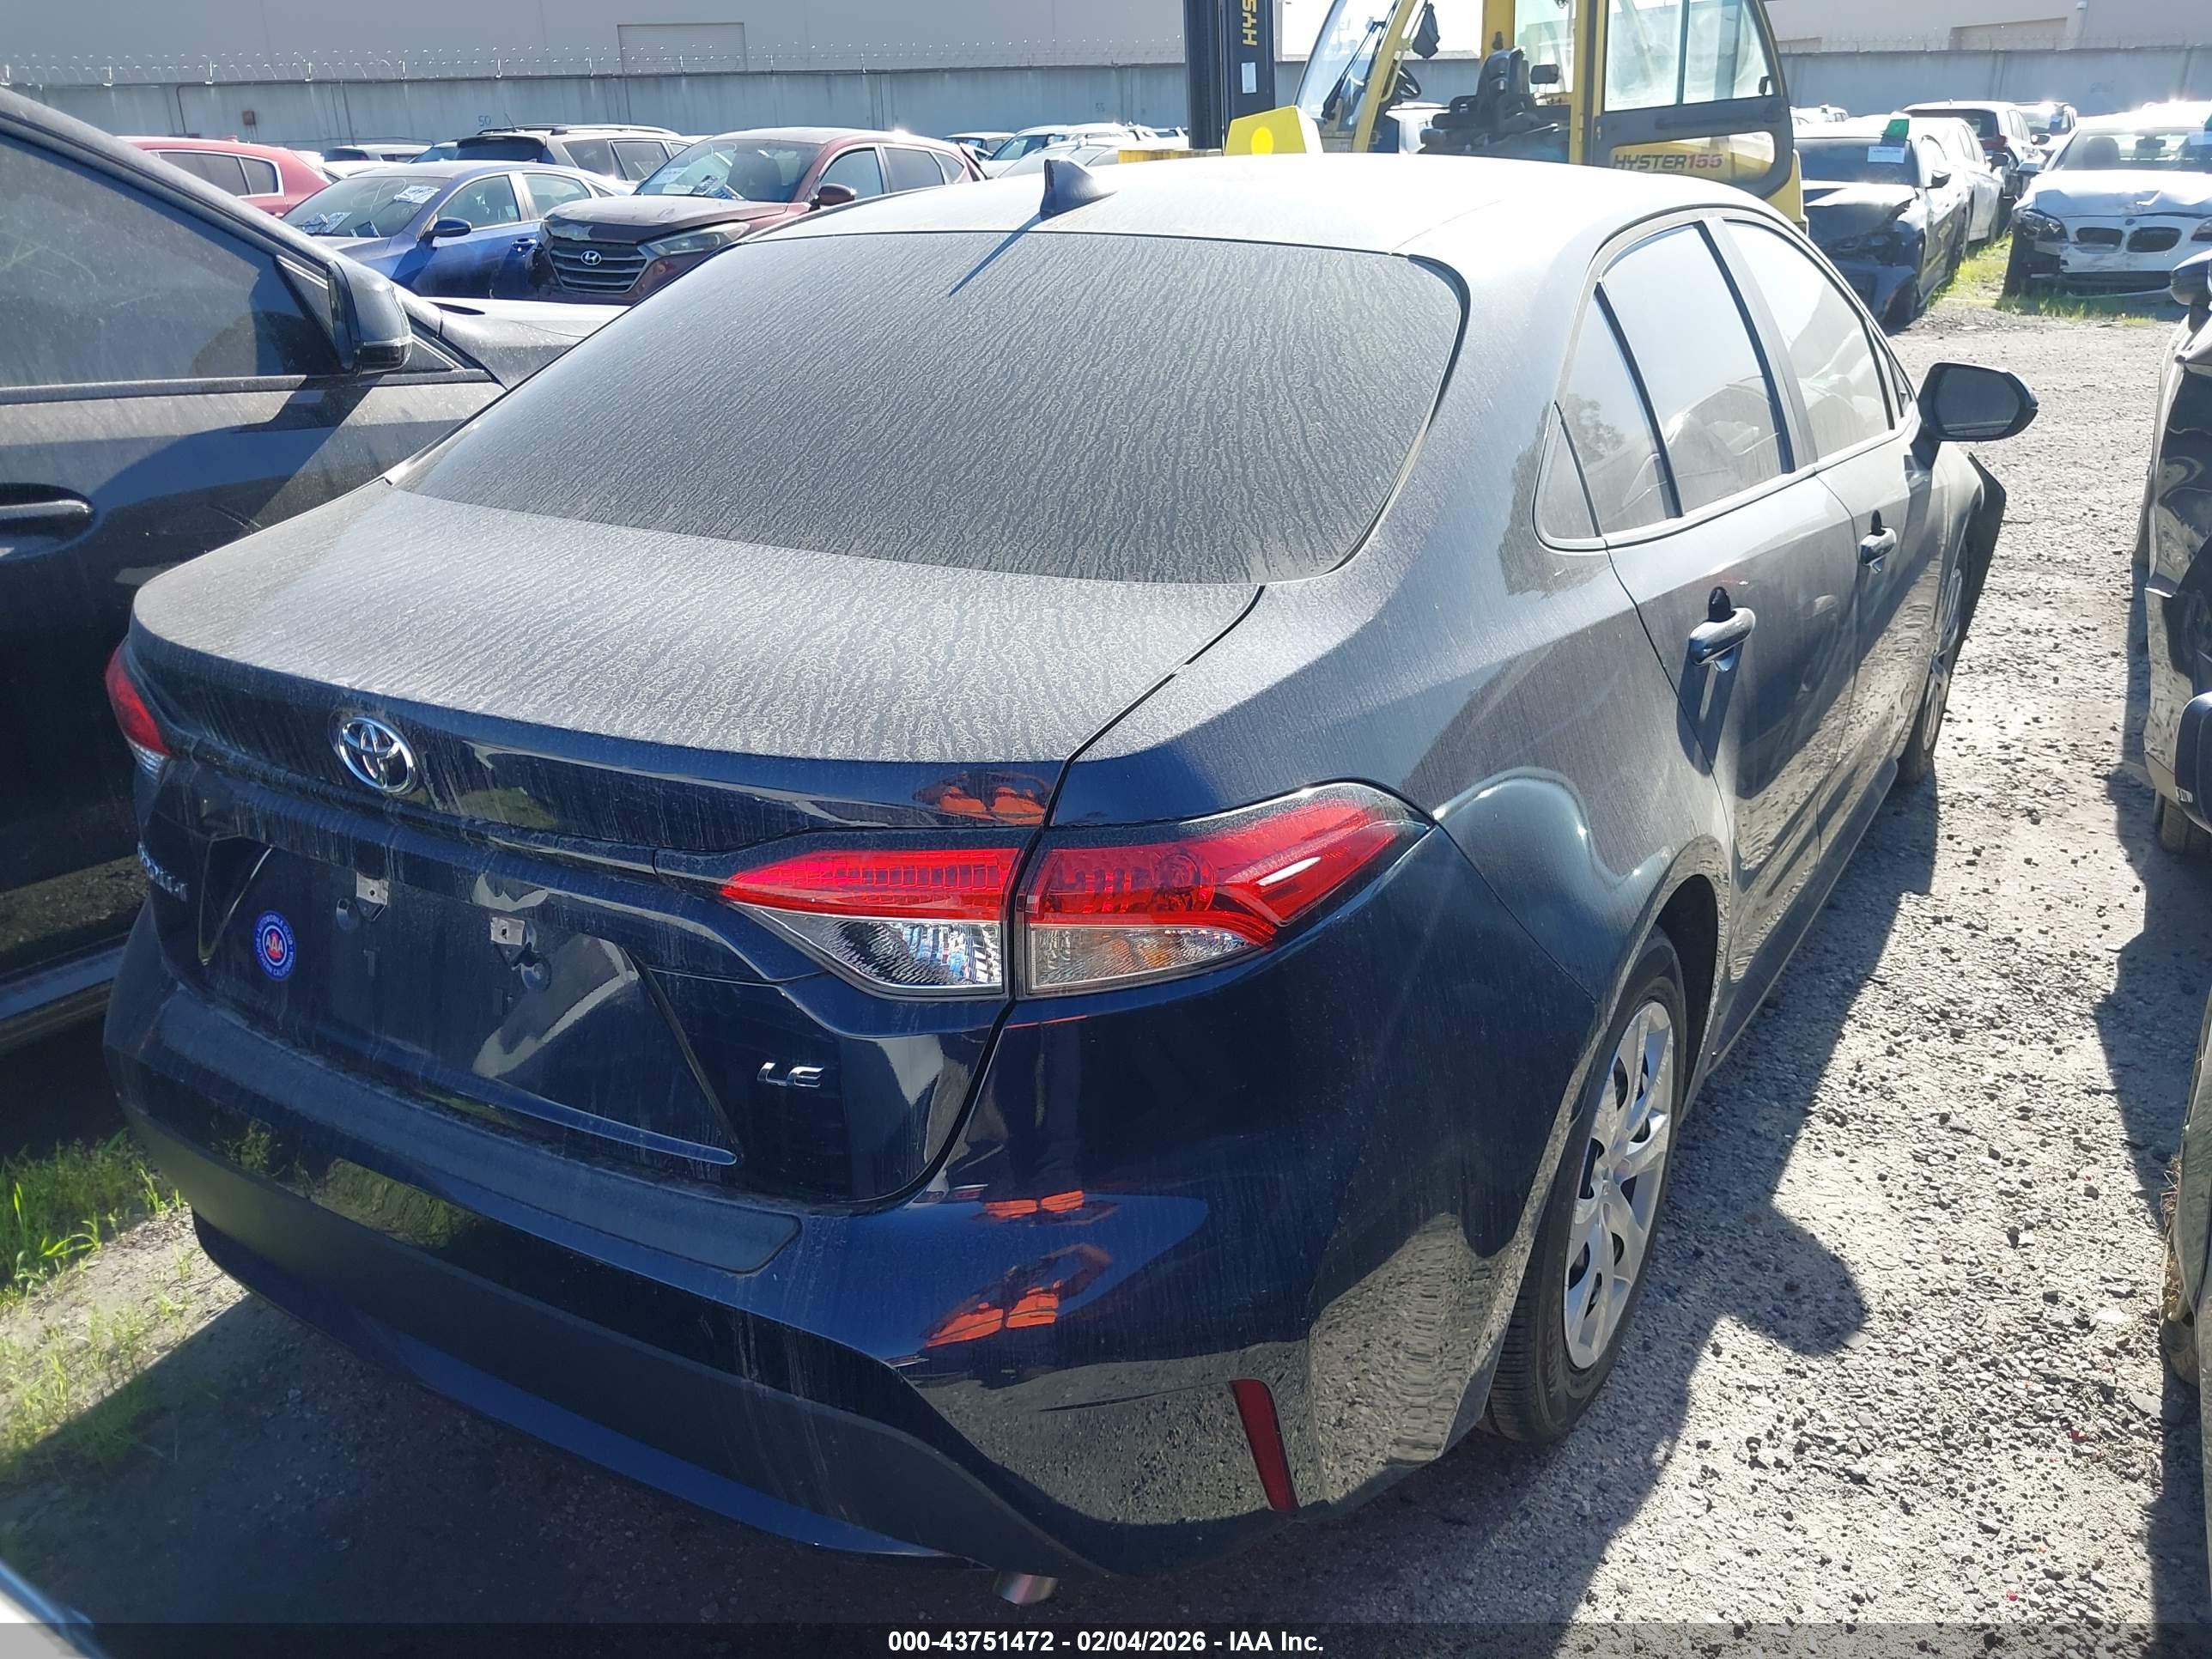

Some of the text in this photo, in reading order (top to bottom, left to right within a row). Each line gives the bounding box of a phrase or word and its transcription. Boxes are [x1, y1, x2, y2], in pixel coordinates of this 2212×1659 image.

[477, 115, 492, 127] 50
[265, 933, 284, 953] AAA
[757, 1061, 824, 1088] LE
